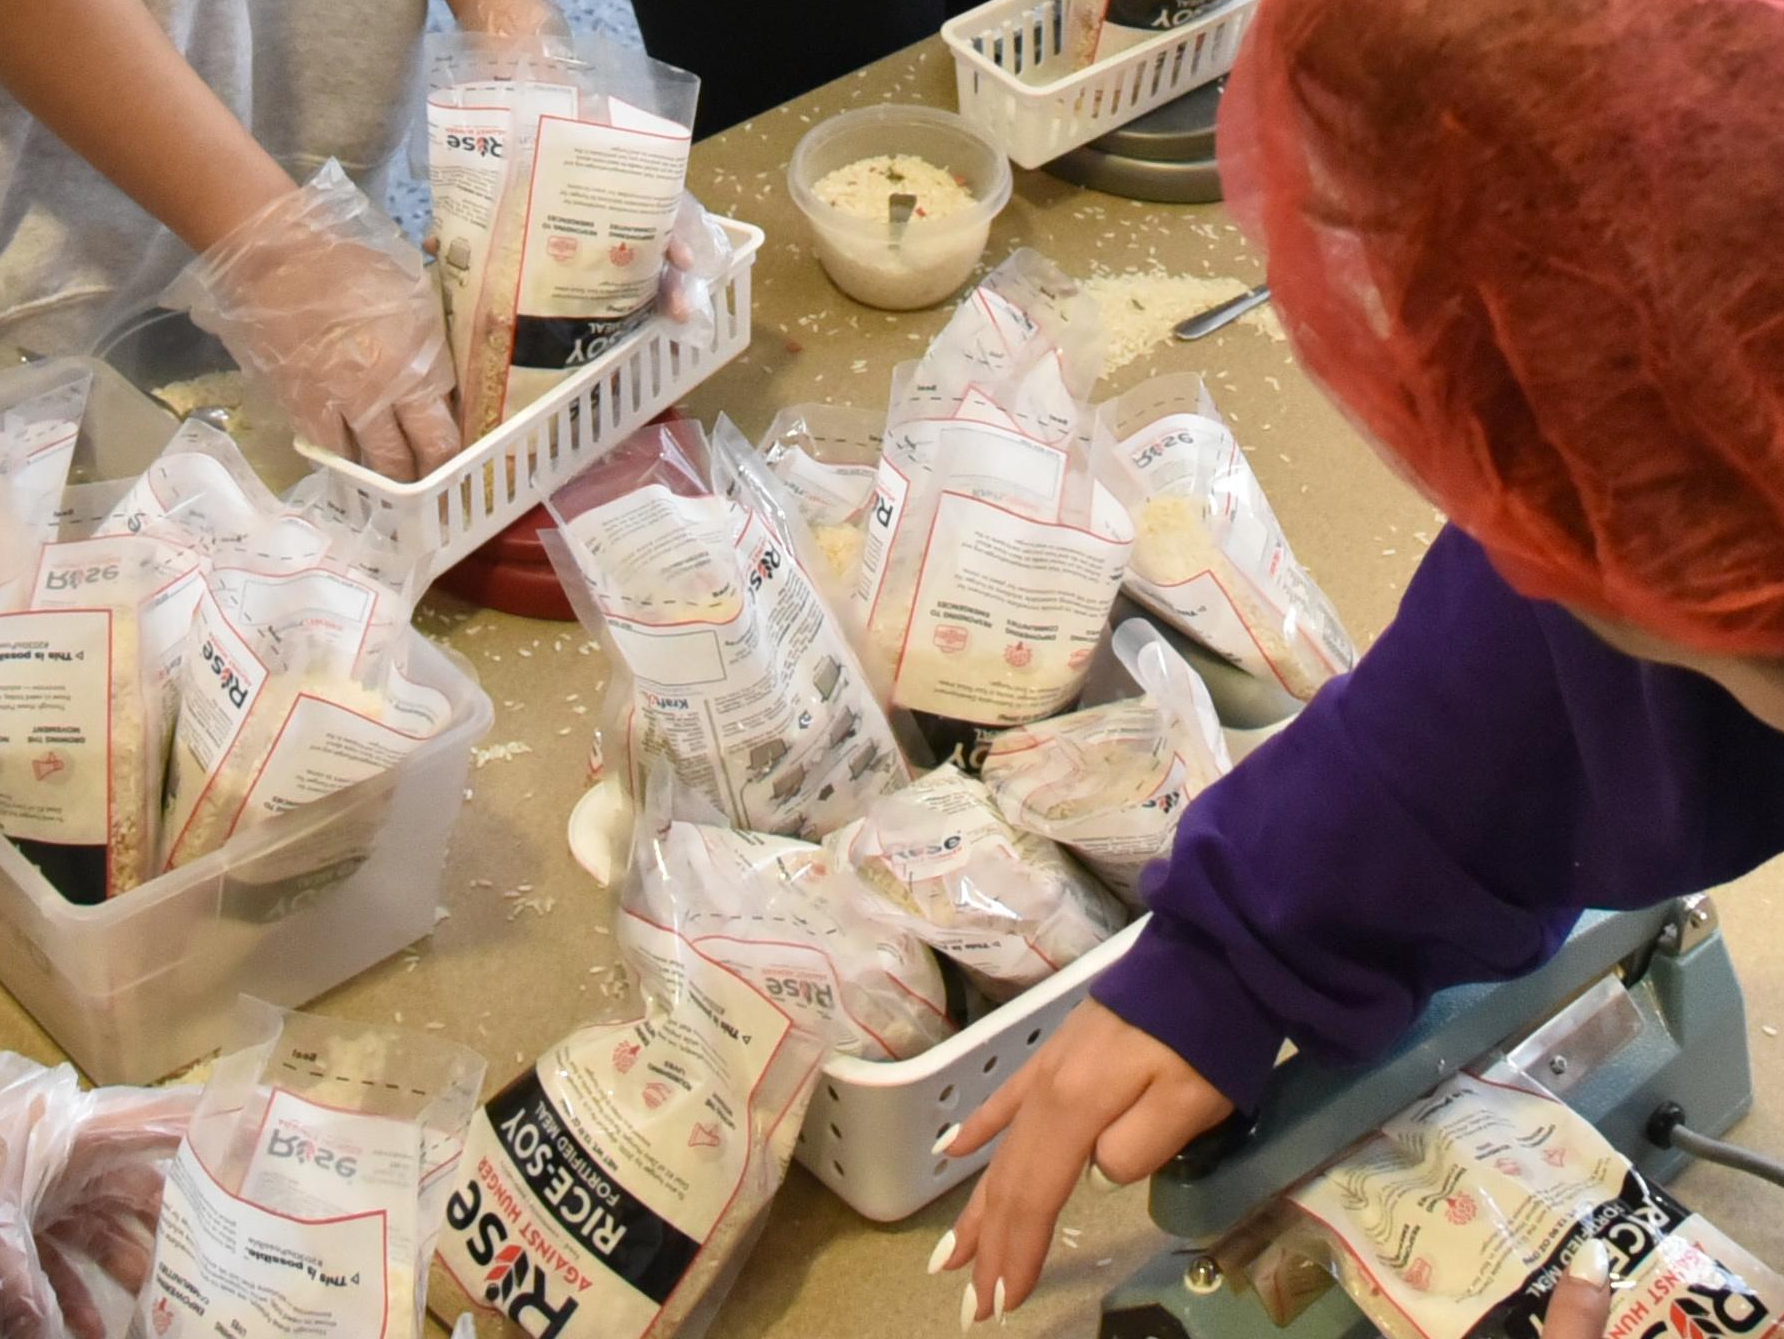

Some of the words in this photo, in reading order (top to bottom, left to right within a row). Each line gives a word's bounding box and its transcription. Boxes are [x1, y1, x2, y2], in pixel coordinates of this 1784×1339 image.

[34, 651, 45, 661] is
[47, 651, 73, 661] This
[534, 1100, 561, 1138] MEAL
[477, 1155, 523, 1224] HUNGER
[500, 1106, 628, 1256] RICE-SOY
[556, 1135, 621, 1207] FORTIFIED
[306, 1266, 317, 1281] is
[319, 1272, 348, 1288] This
[446, 1179, 579, 1339] Rise
[518, 1219, 594, 1293] AGAINST
